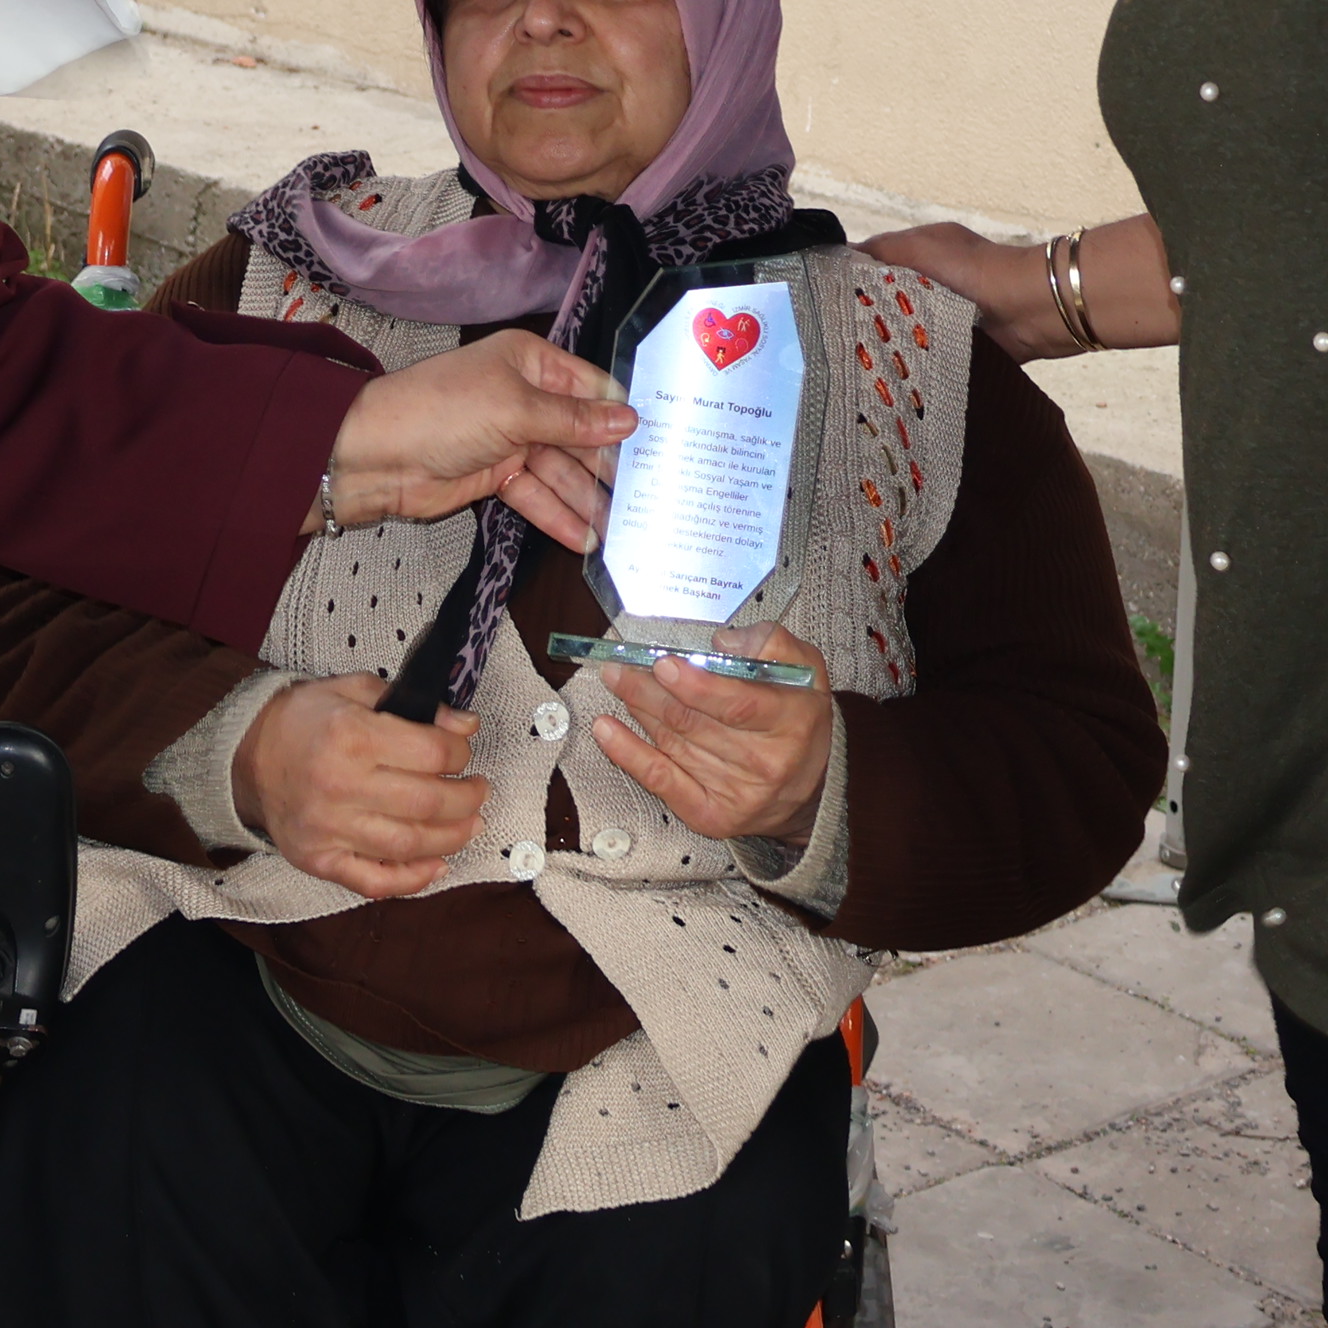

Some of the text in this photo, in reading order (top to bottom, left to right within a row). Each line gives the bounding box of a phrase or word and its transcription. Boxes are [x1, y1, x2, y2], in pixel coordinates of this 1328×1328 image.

[692, 396, 724, 411] Murat
[727, 402, 773, 418] Topoğlu
[741, 463, 776, 477] kurulan
[693, 470, 725, 484] Sosyal
[727, 475, 759, 488] Yaşam
[761, 482, 773, 491] ve
[705, 486, 749, 502] Engelliler
[710, 577, 744, 590] Bayrak
[682, 586, 721, 601] Başkanı
